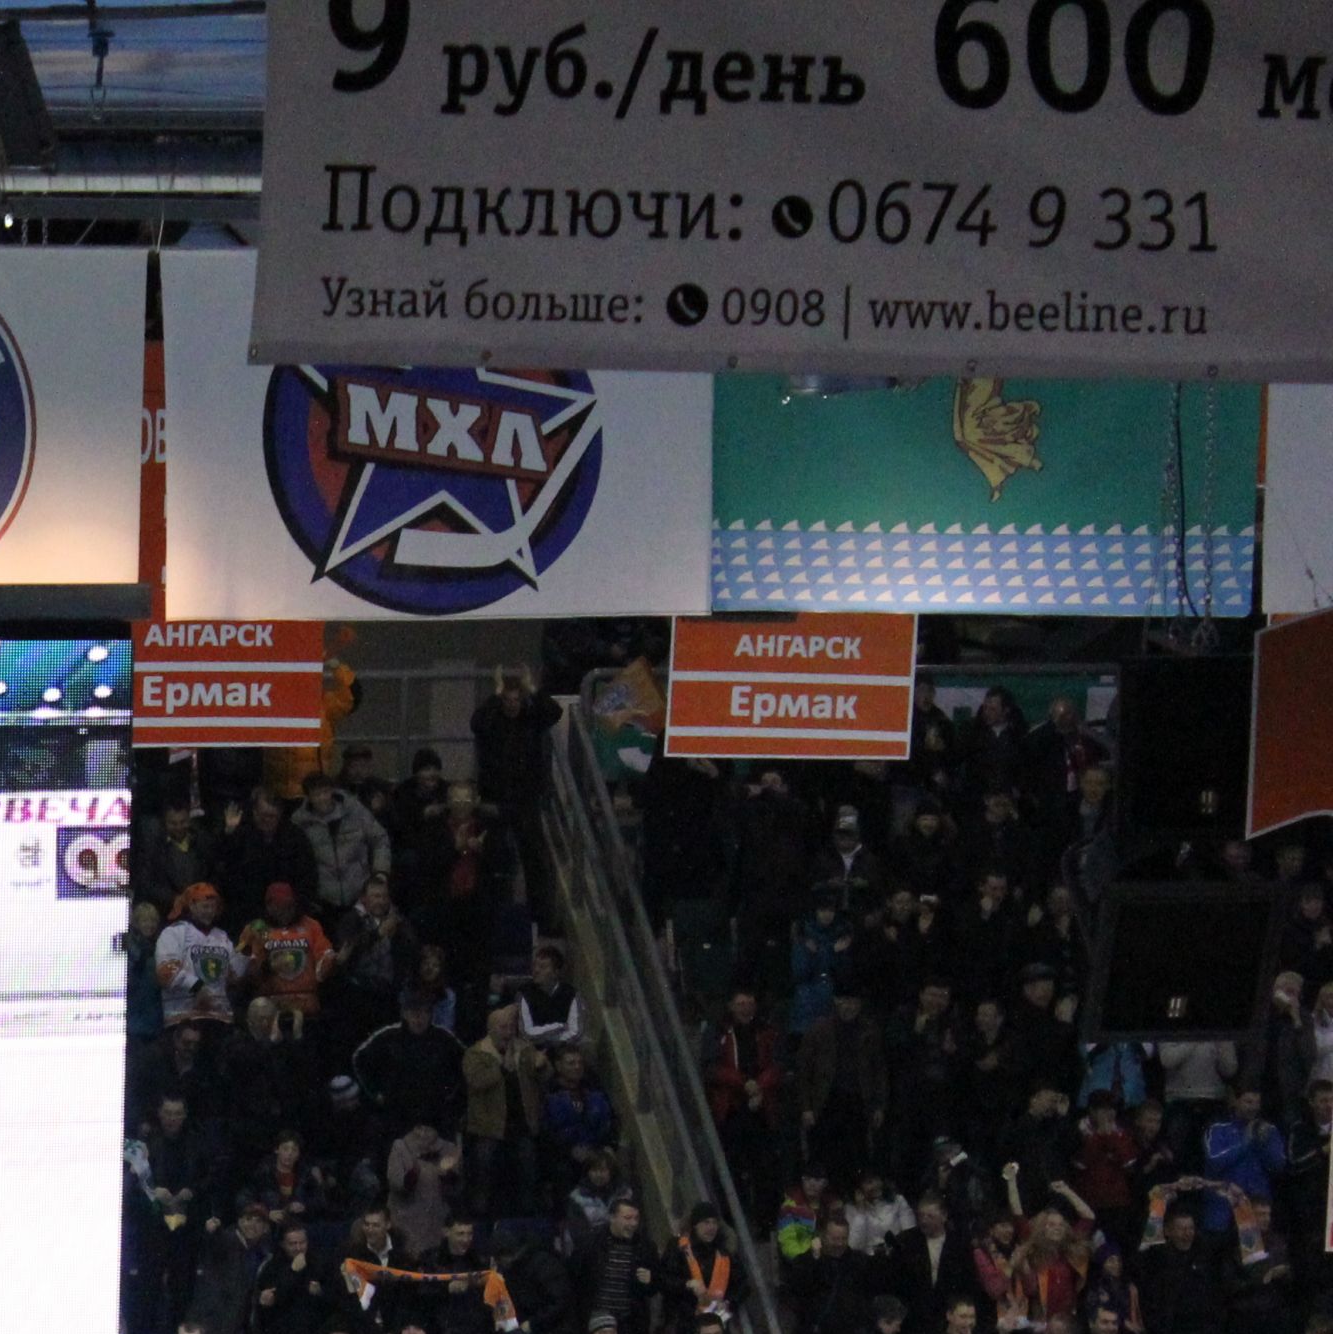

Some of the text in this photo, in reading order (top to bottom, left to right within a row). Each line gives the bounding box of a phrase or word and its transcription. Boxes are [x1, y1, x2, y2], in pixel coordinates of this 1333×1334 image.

[440, 26, 866, 119] руб./день
[935, 0, 1215, 116] 600
[1258, 52, 1333, 120] М
[322, 165, 1219, 254] Подключи: 0674 9 331
[322, 277, 450, 326] Узнай
[464, 279, 645, 326] больше:
[722, 288, 824, 329] 0908
[870, 289, 1209, 336] www.beeline.ru
[346, 383, 547, 472] МХЛ
[143, 623, 274, 648] АНГАРСК
[735, 634, 861, 660] АНГАРСК
[141, 675, 272, 714] Ермак
[730, 686, 857, 724] Ермак
